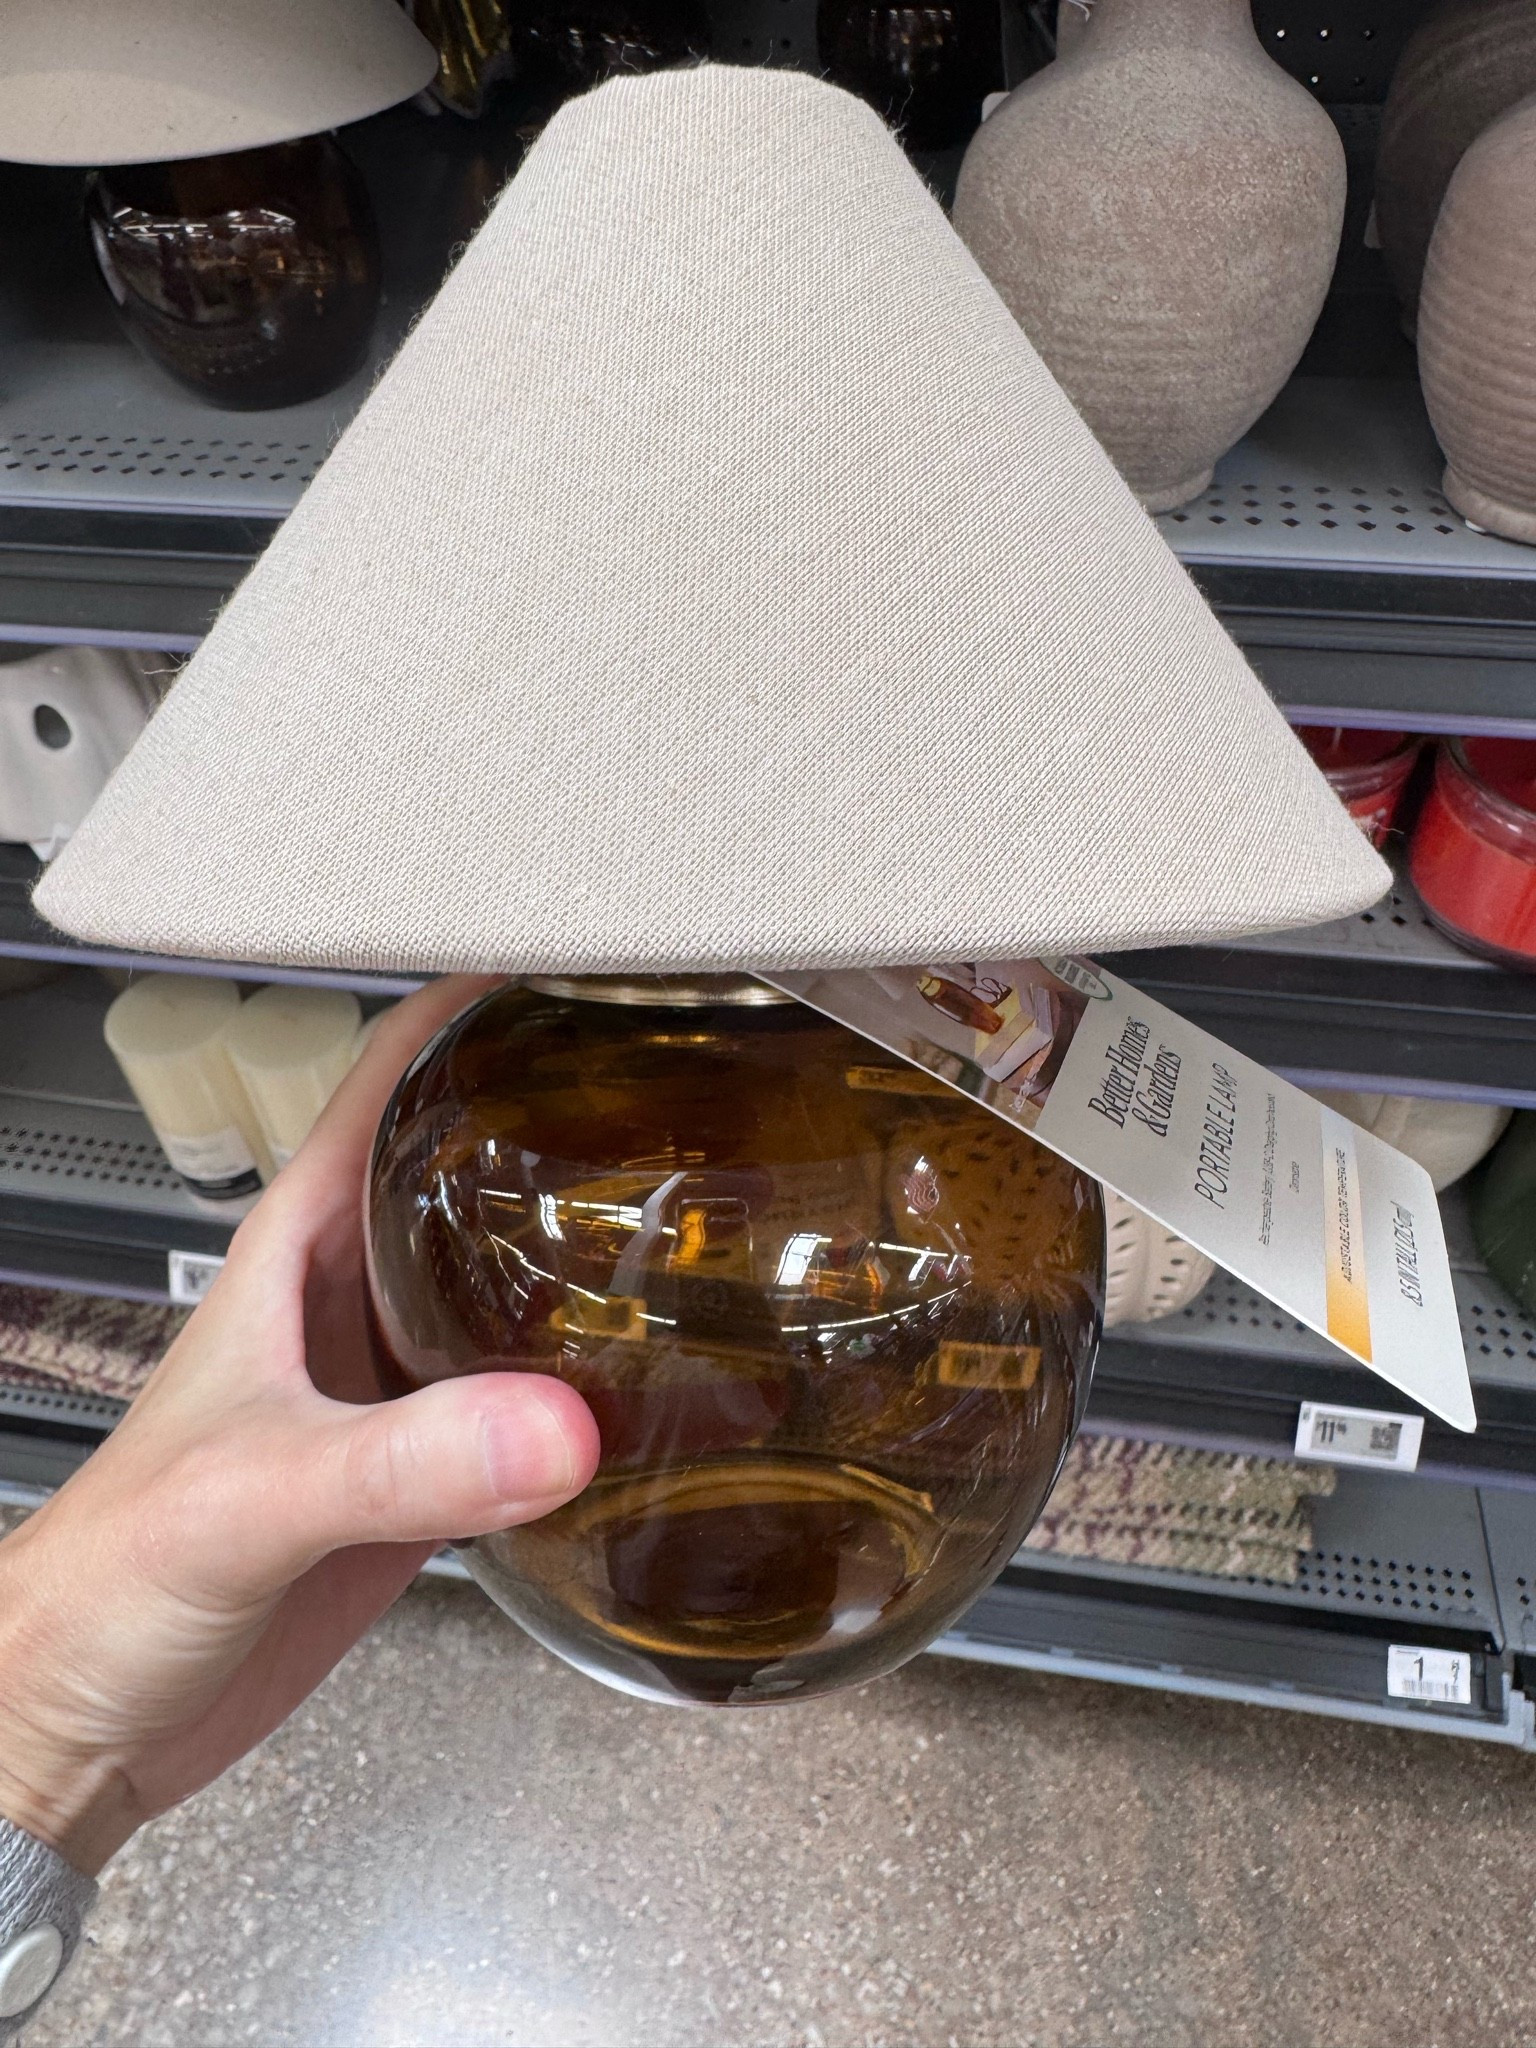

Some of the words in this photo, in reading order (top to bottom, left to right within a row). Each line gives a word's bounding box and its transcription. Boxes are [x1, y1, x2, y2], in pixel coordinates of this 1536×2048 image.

[1105, 1018, 1151, 1074] Homes
[1088, 1065, 1135, 1129] Better
[1136, 1048, 1182, 1120] Gardens
[1208, 1062, 1238, 1112] LAMP
[1131, 1107, 1167, 1137] &
[1194, 1103, 1234, 1209] PORTABLE
[1396, 1243, 1418, 1275] TALL
